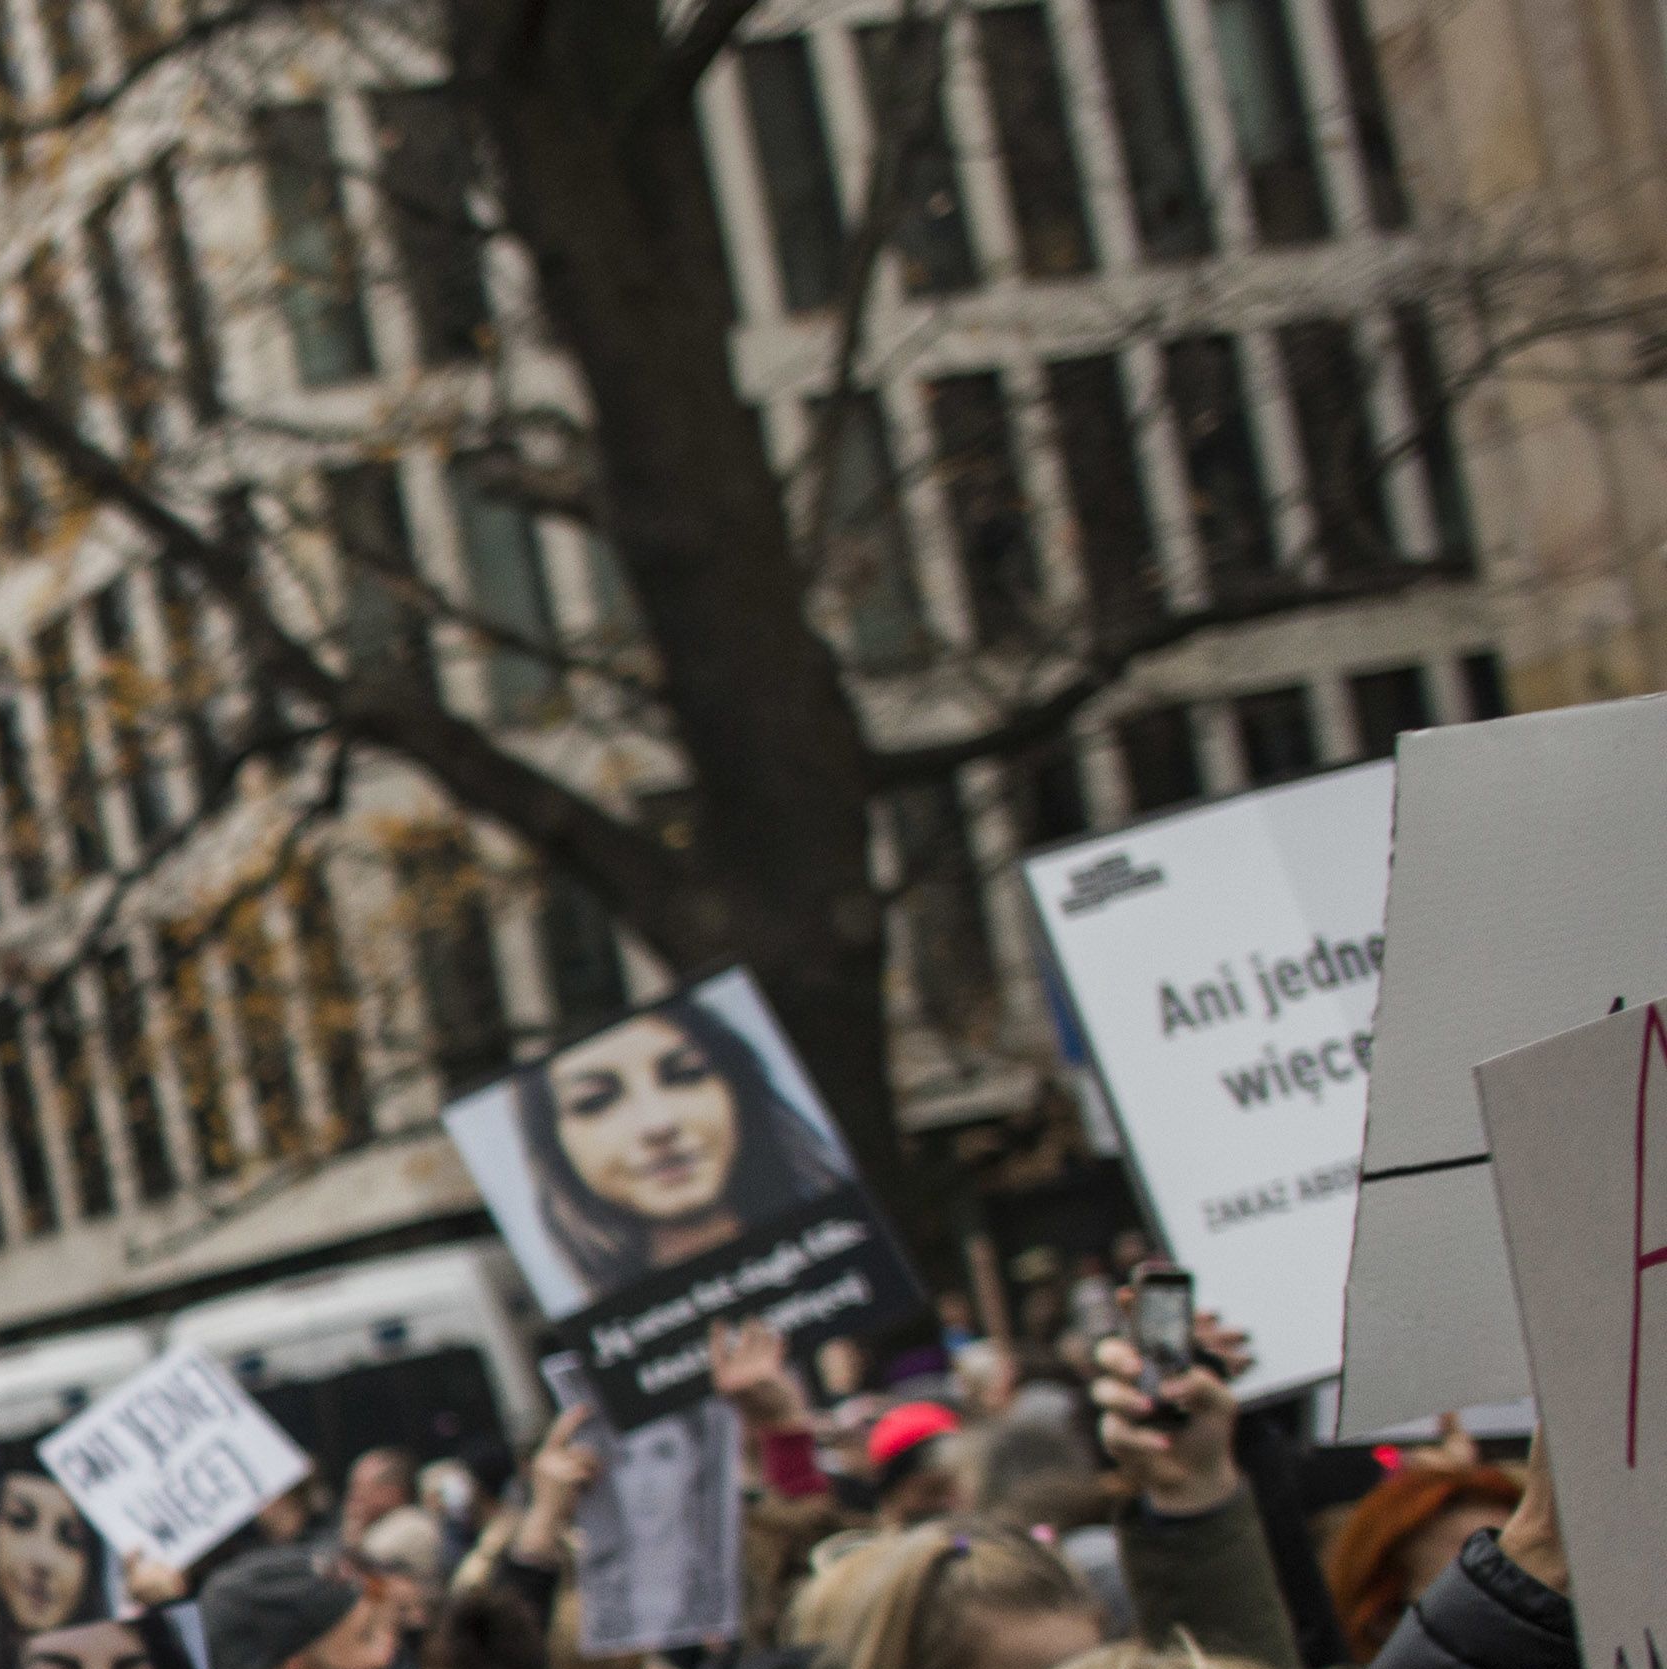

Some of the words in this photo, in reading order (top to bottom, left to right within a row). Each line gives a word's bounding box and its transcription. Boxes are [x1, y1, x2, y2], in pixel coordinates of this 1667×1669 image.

[1158, 961, 1247, 1038] Ani
[1249, 931, 1386, 1021] jedne
[1220, 1030, 1374, 1112] więce
